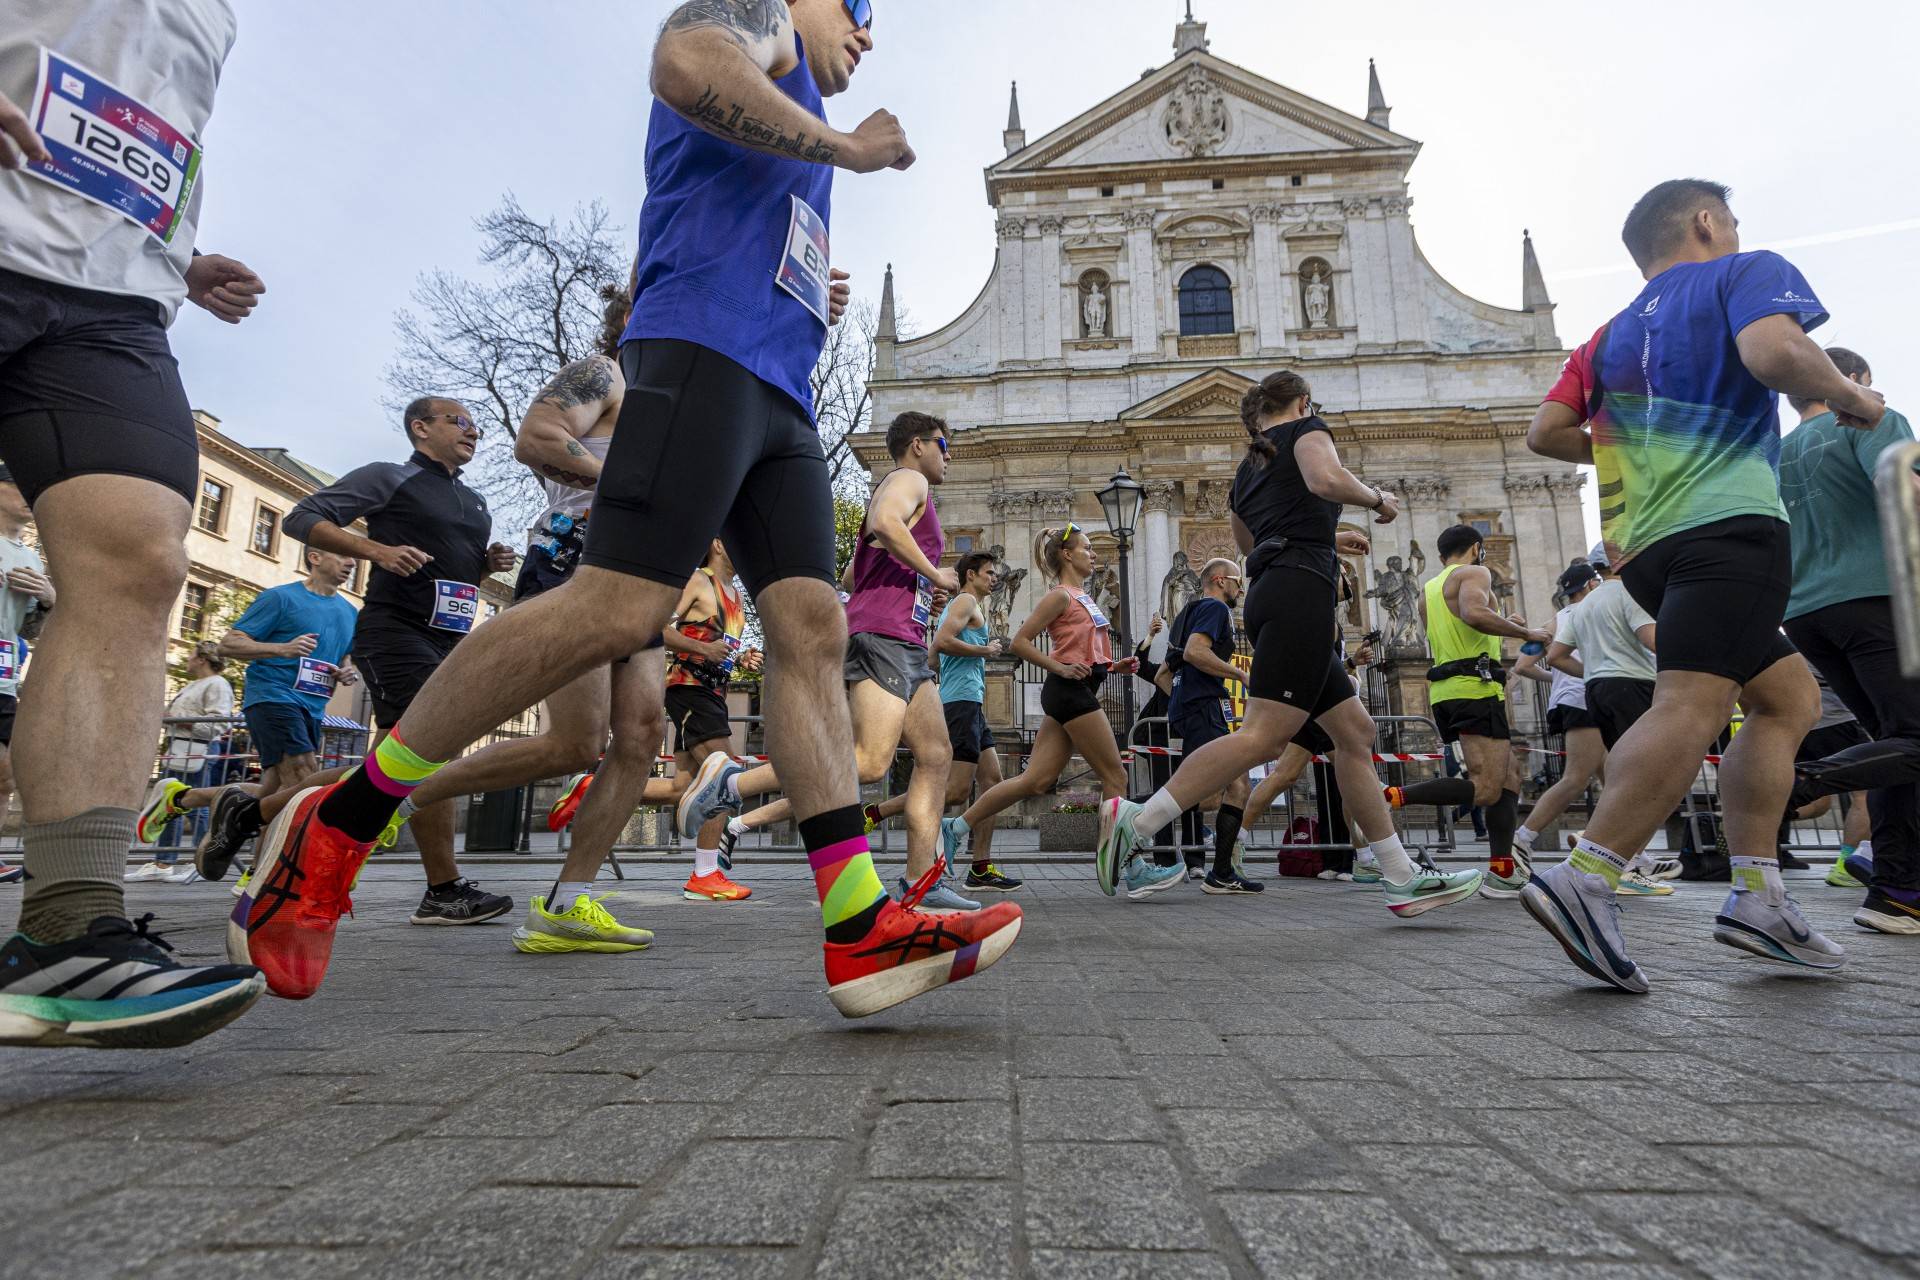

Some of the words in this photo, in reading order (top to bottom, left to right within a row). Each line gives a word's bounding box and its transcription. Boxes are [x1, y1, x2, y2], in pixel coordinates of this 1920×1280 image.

[70, 112, 171, 193] 1269
[739, 117, 777, 142] never
[776, 132, 804, 155] walk
[1589, 846, 1625, 868] KIPRUN
